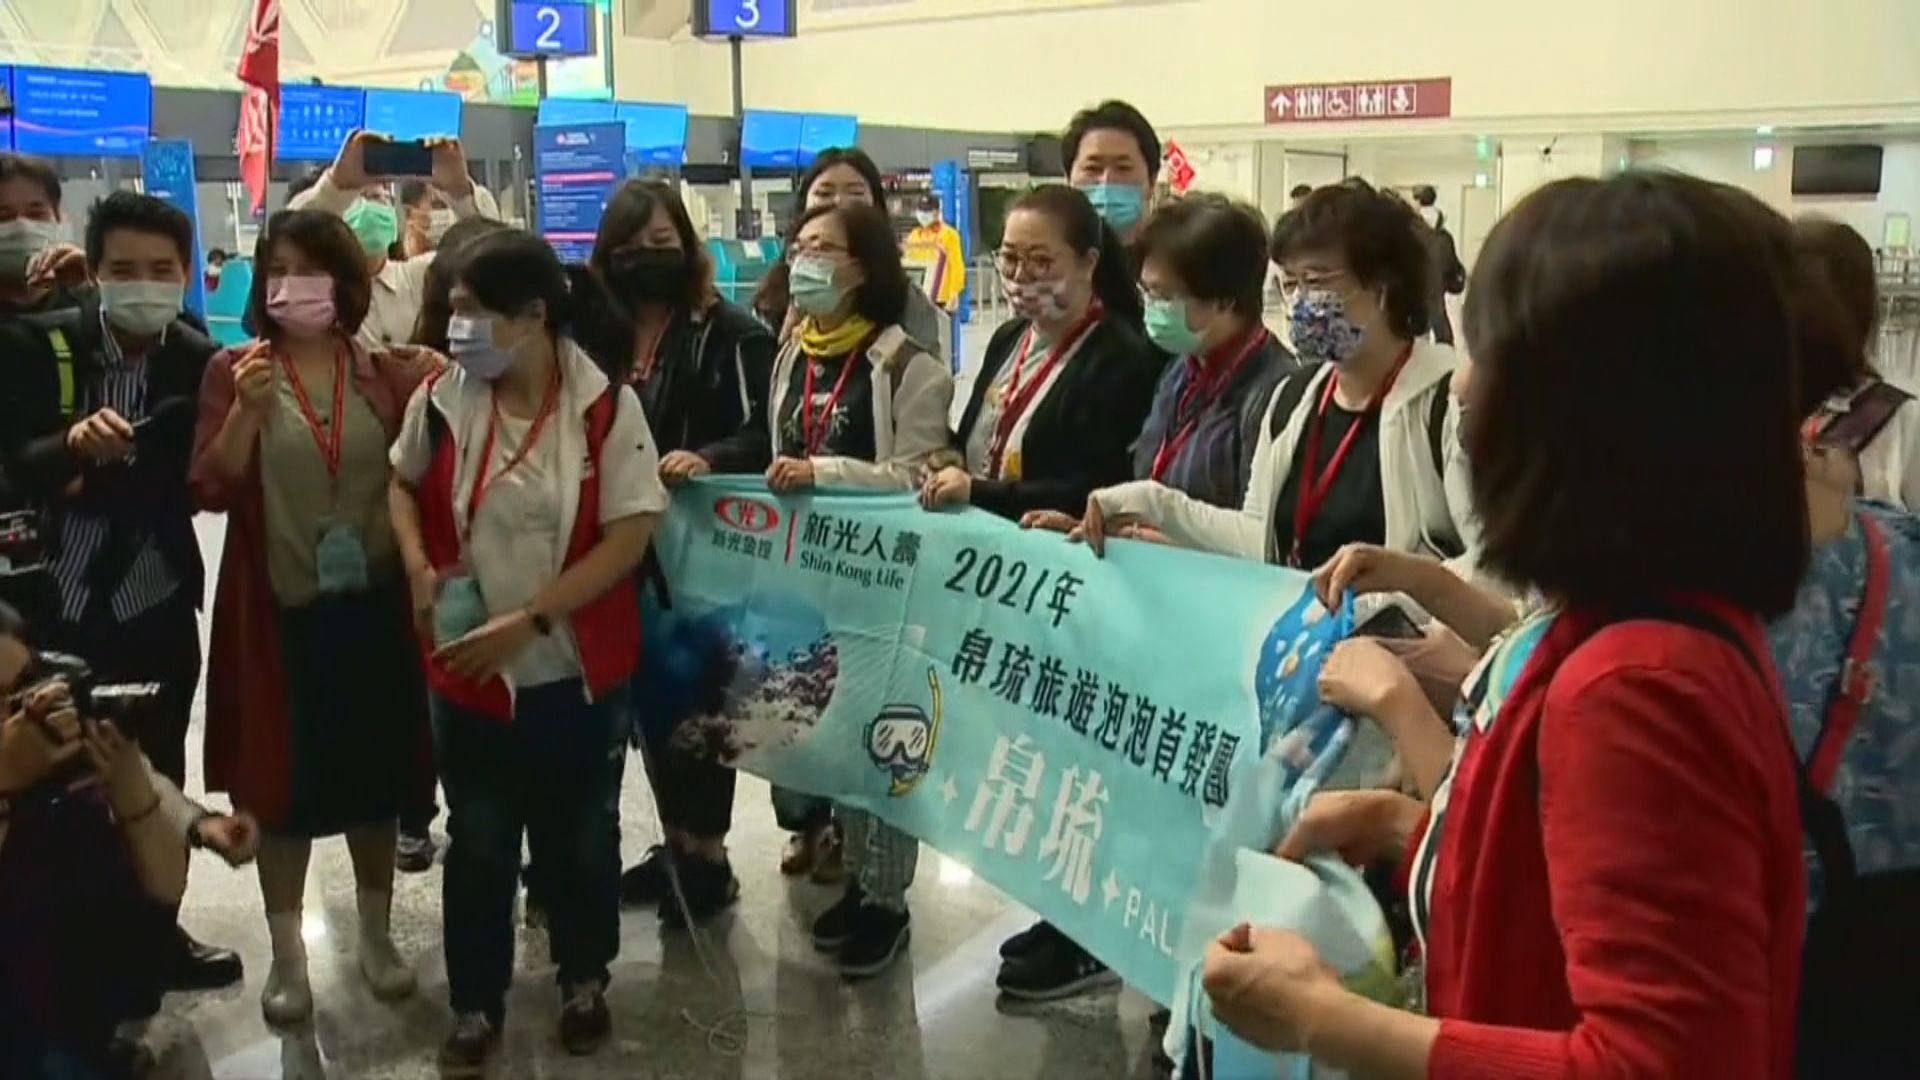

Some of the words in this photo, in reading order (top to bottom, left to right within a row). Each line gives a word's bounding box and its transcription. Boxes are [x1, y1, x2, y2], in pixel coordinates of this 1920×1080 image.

[535, 7, 561, 48] 2
[735, 0, 759, 28] 3
[801, 511, 922, 568] 新光人壽
[800, 550, 832, 574] Shin
[835, 560, 872, 588] Kong
[876, 567, 905, 591] Life
[944, 547, 1085, 628] 2021年
[964, 734, 1110, 905] 帛琉
